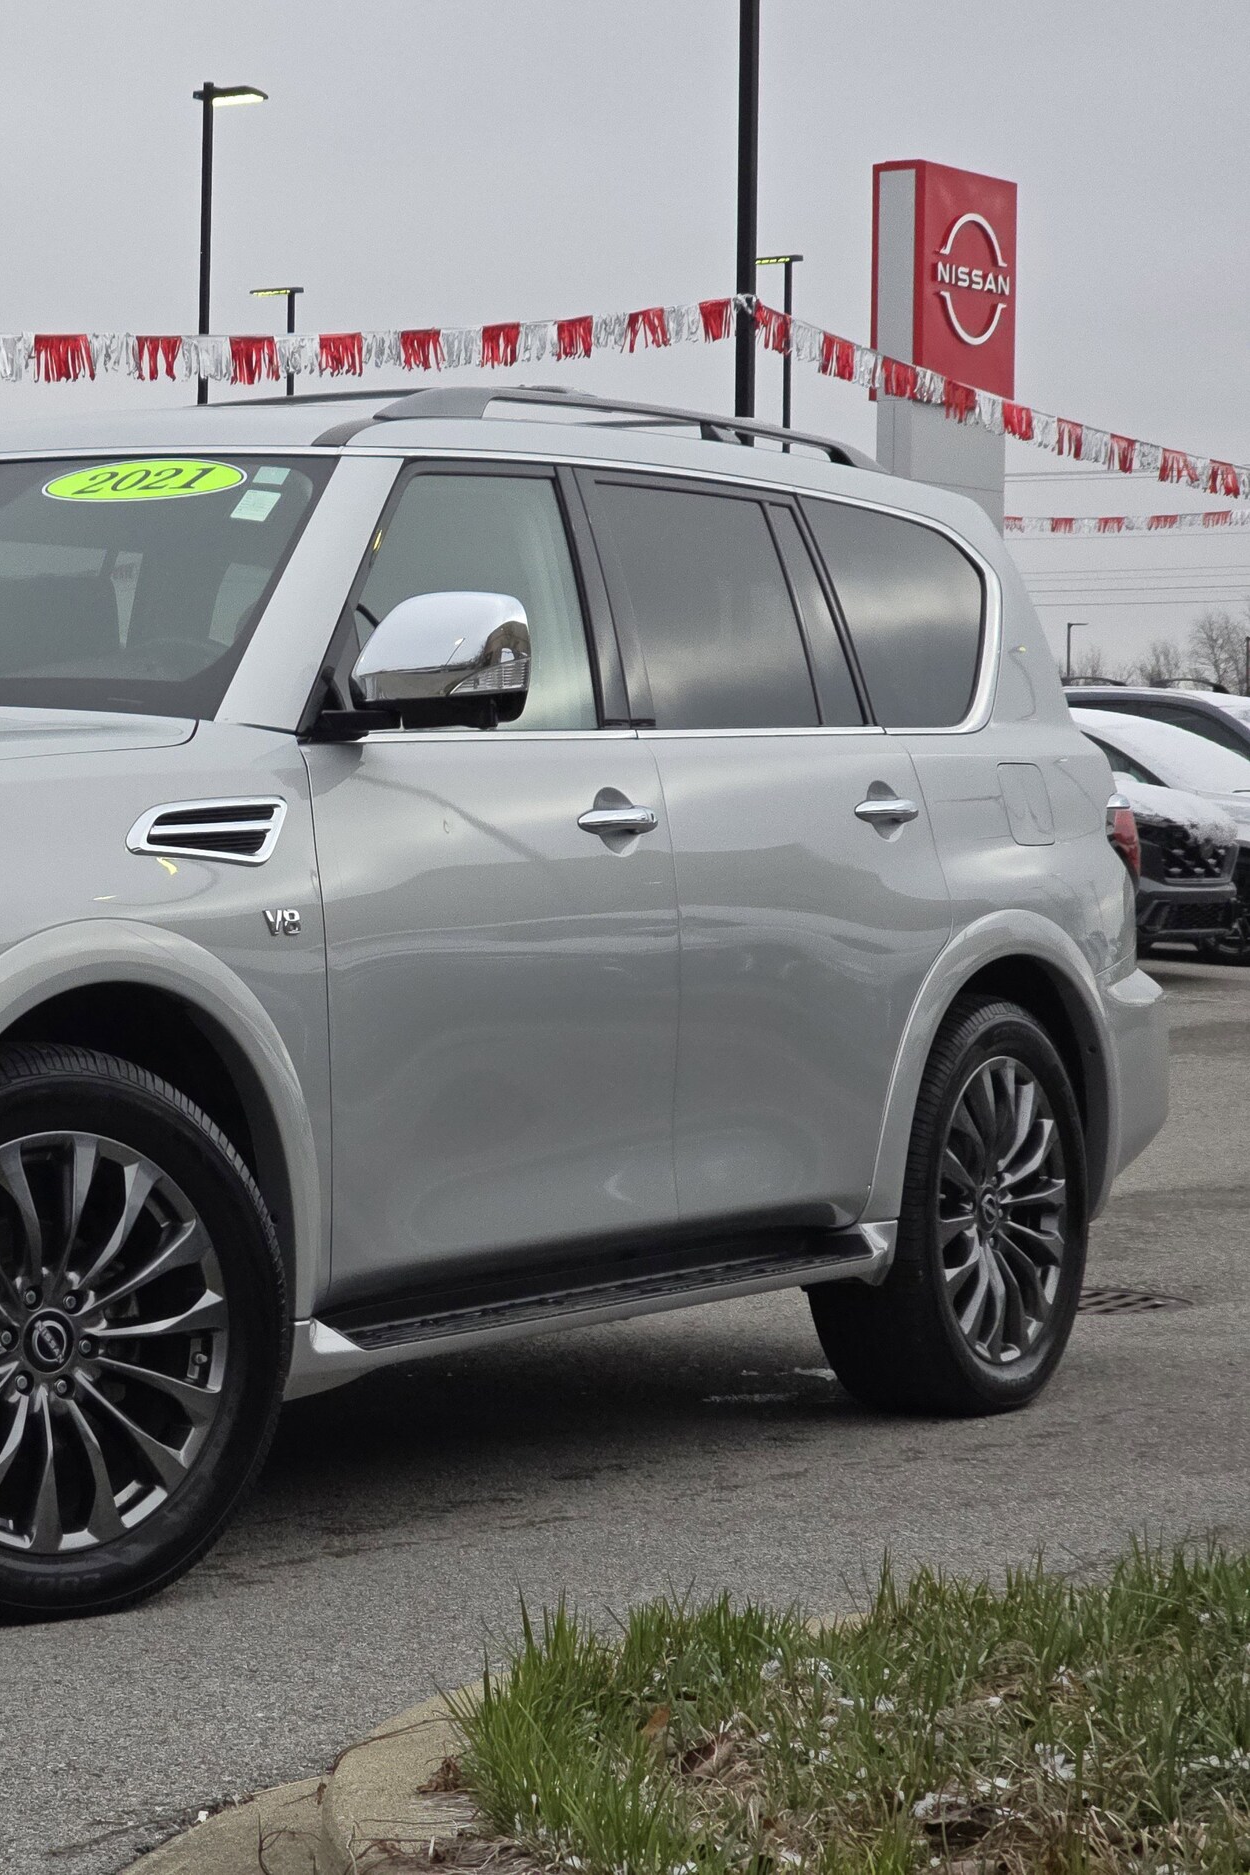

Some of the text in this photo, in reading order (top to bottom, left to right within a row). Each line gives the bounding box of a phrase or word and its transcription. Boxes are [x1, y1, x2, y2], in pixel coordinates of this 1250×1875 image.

[937, 261, 1010, 296] NISSAN
[71, 466, 217, 496] 2021
[262, 908, 301, 936] V8
